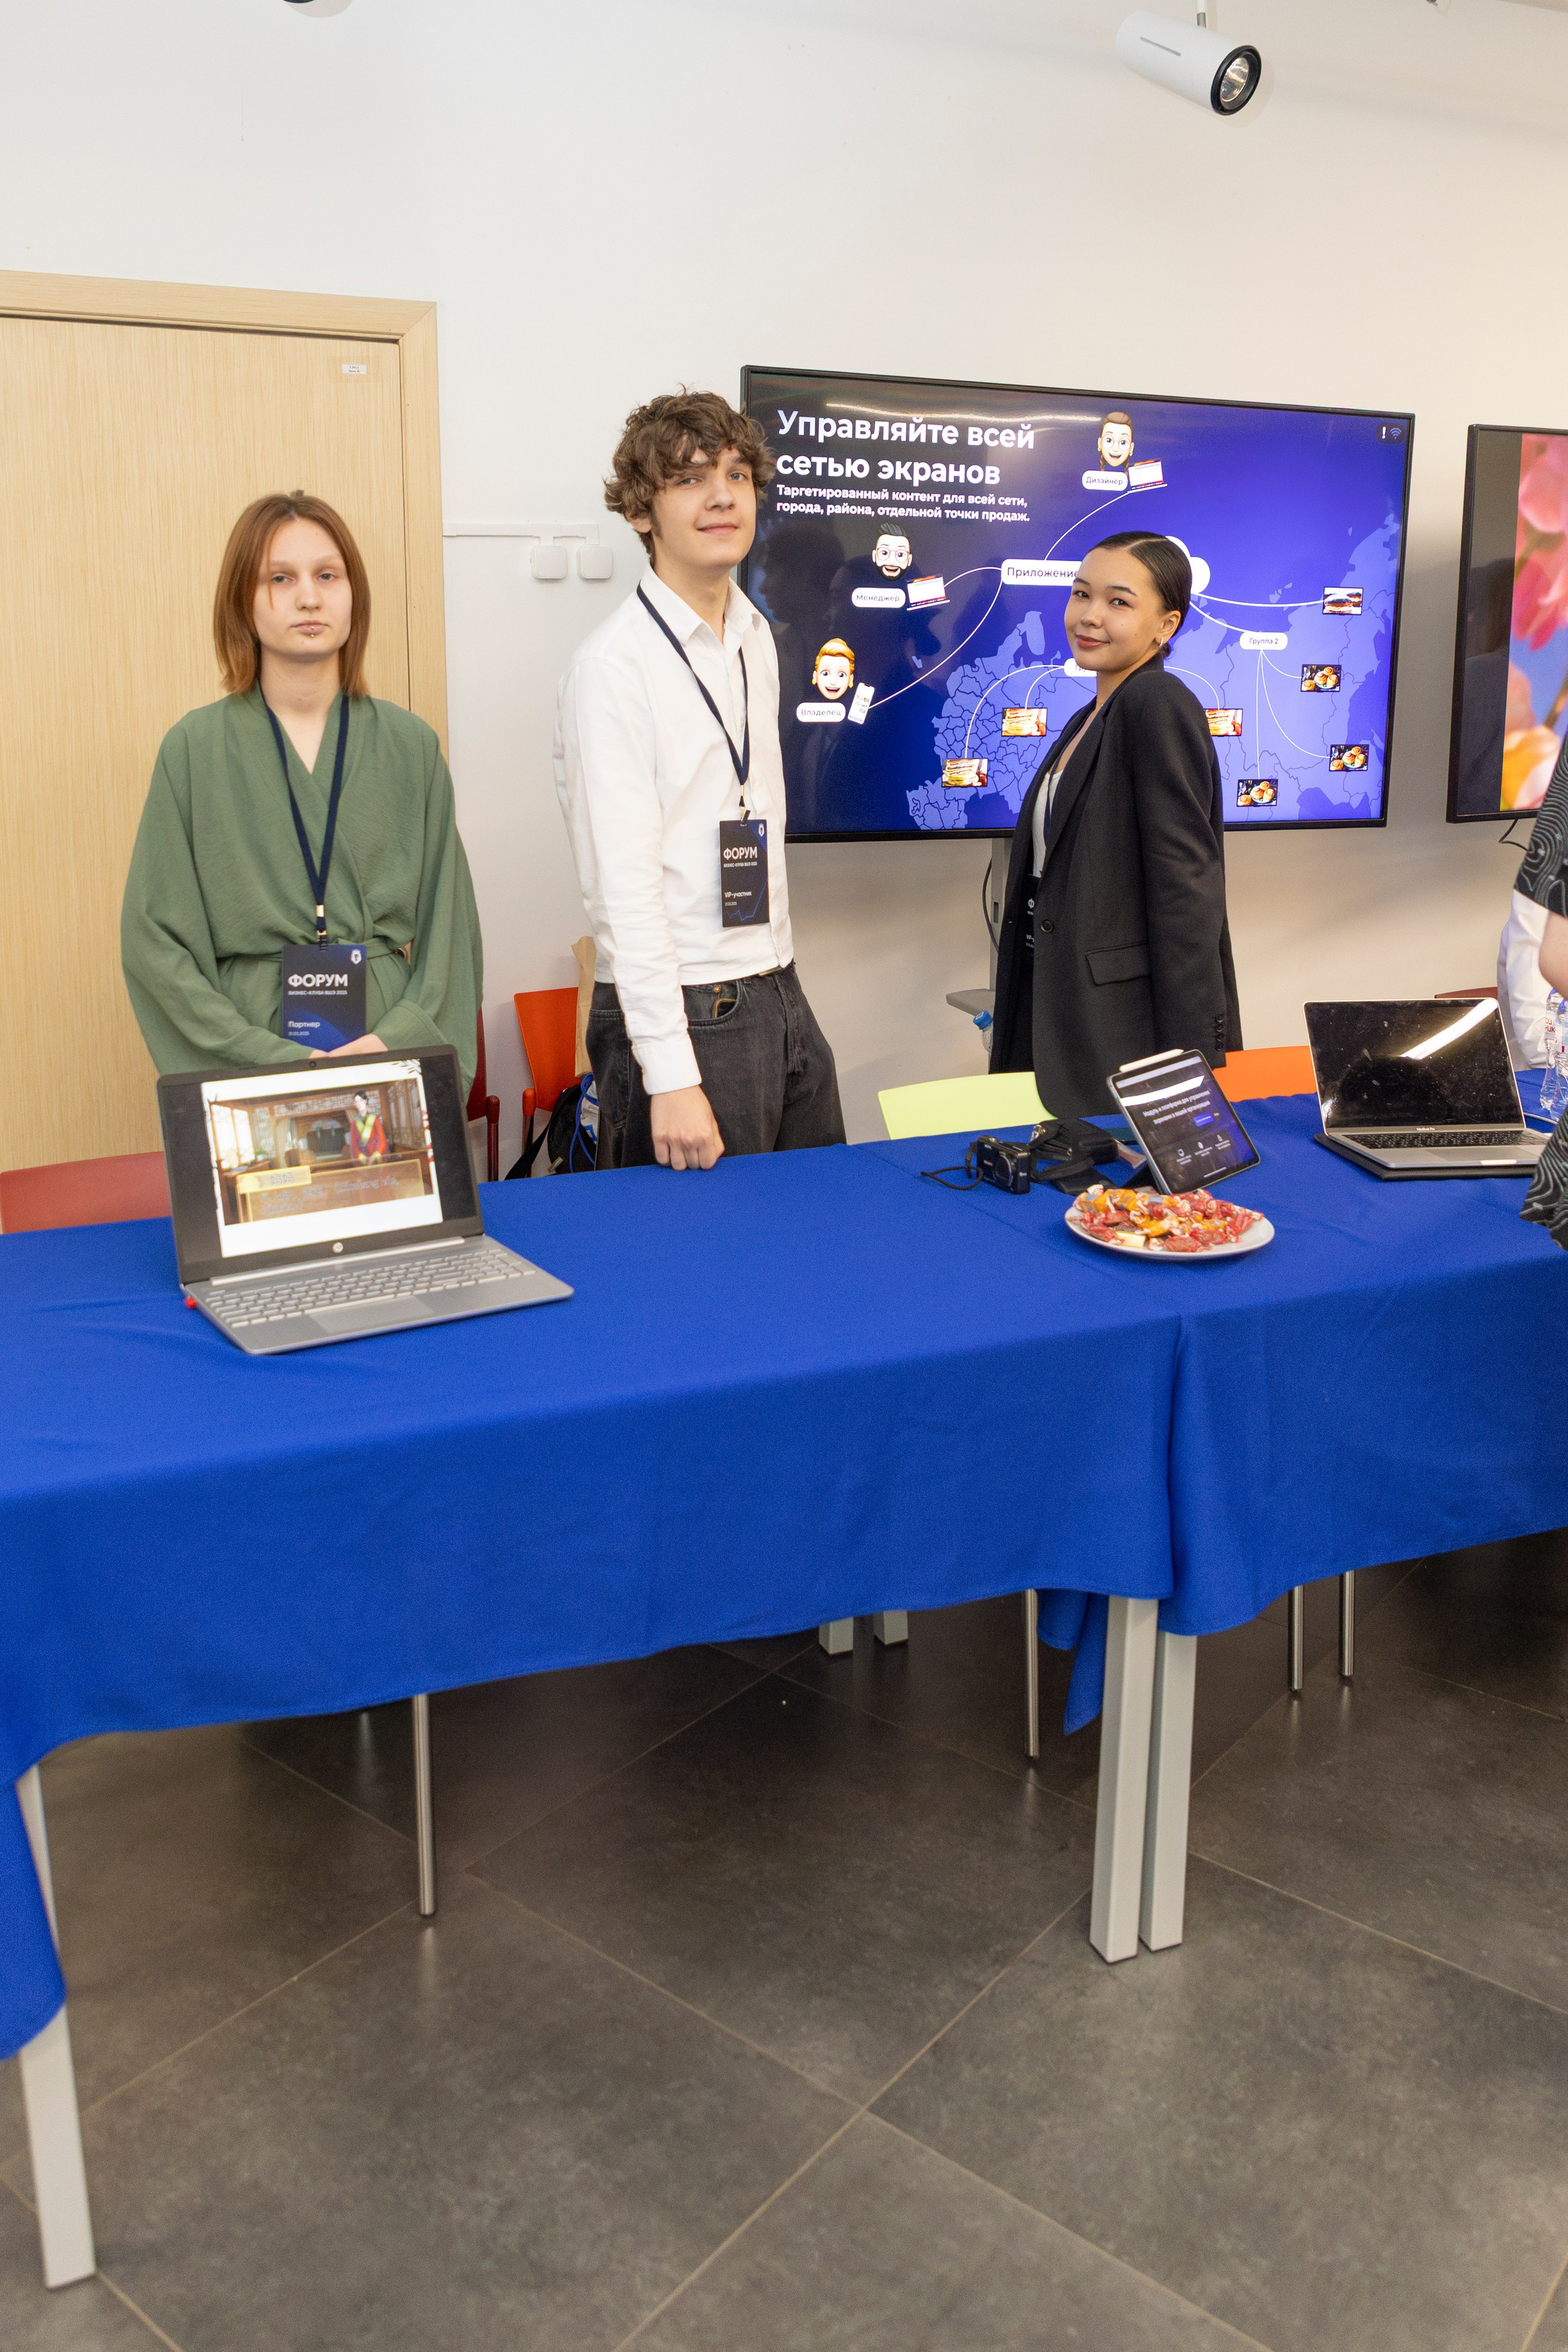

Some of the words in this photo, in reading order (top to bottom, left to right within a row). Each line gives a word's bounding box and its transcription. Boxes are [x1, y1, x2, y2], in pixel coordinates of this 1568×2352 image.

[777, 409, 959, 444] Управляйте
[967, 423, 1034, 450] всей
[777, 454, 869, 478] сетью
[877, 459, 1000, 486] экранов
[1086, 477, 1123, 486] Дизайнер
[777, 484, 889, 500] Таргетированный
[892, 492, 940, 502] контент
[942, 494, 965, 505] для
[968, 494, 995, 505] всей
[998, 496, 1028, 508] сети,
[777, 502, 824, 514] города,
[827, 503, 875, 517] района,
[877, 507, 942, 518] отдельной
[944, 510, 979, 519] точки
[982, 511, 1030, 522] продаж.
[1008, 567, 1079, 578] Приложение
[723, 846, 758, 860] ФОРУМ
[288, 974, 348, 987] ФОРУМ
